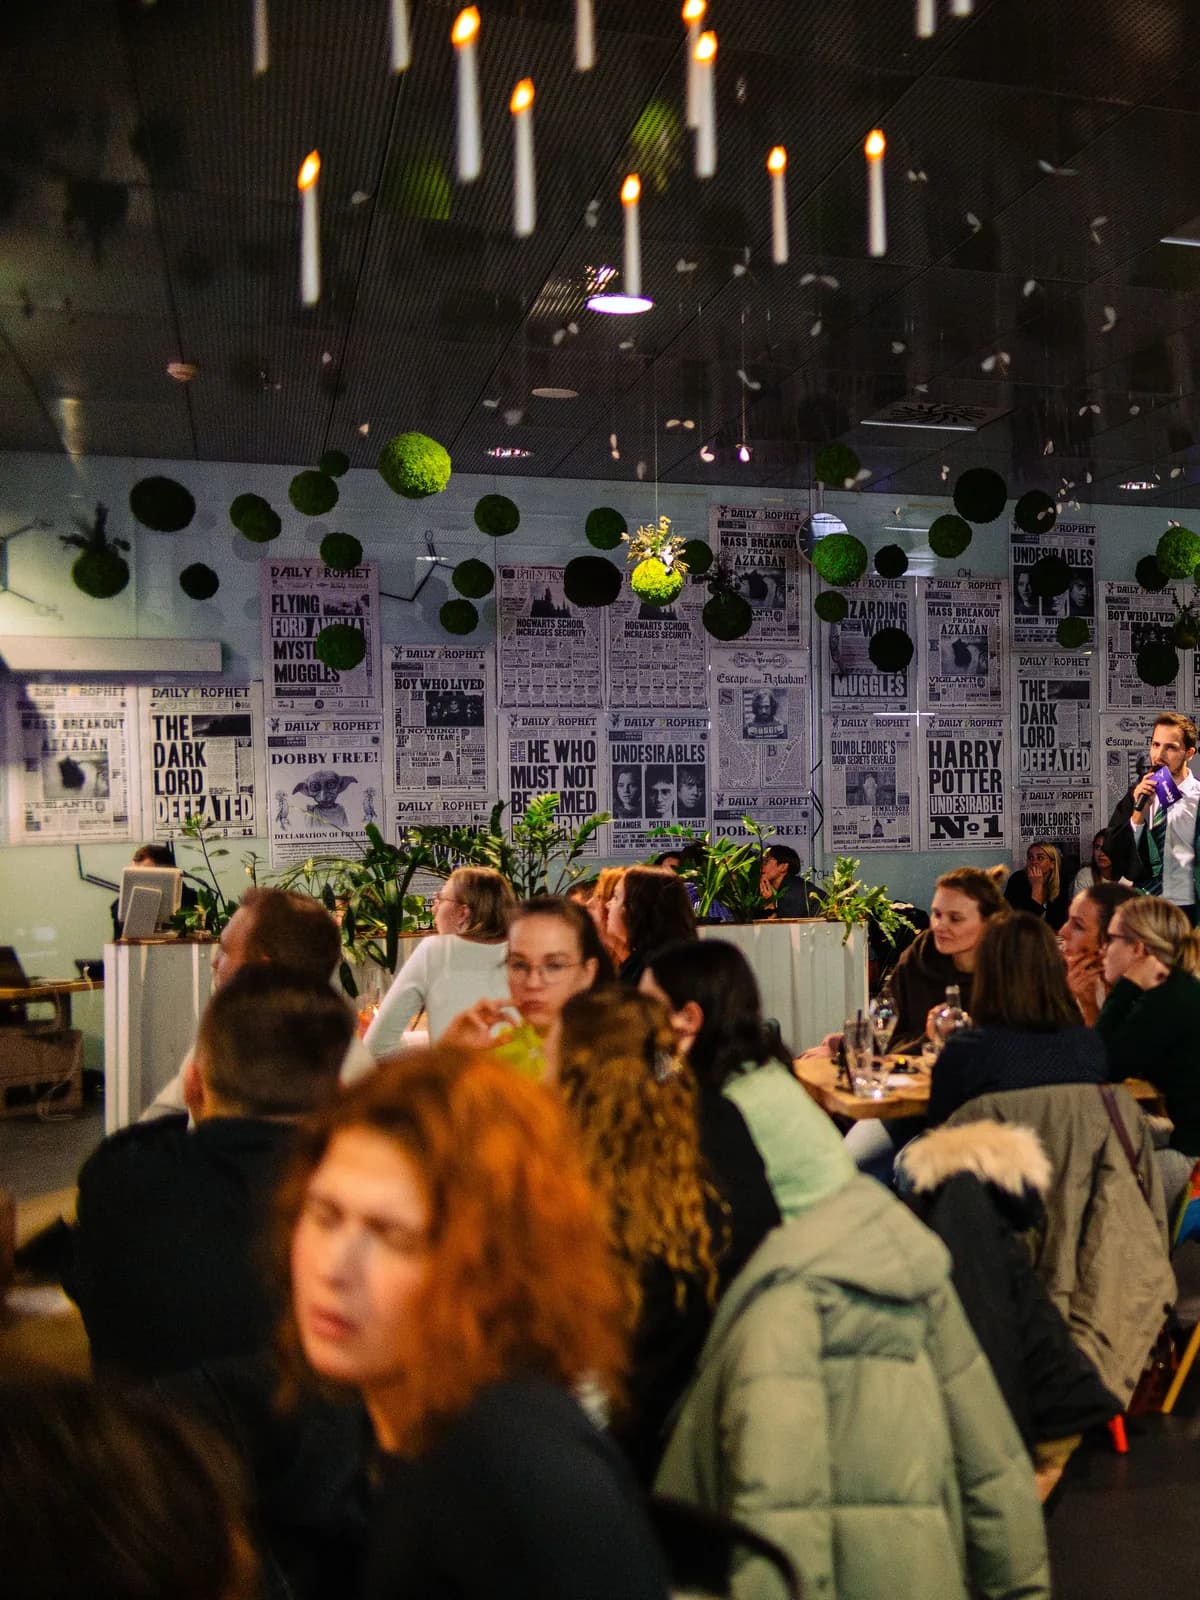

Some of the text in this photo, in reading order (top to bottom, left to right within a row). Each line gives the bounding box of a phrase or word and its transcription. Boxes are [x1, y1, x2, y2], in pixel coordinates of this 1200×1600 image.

[730, 509, 758, 519] DAILY
[720, 537, 798, 549] MASS BREAKOUT
[734, 555, 786, 567] AZKABAN
[270, 566, 312, 578] DAILY
[937, 580, 961, 589] DAILY
[1116, 586, 1139, 594] DAILY
[271, 594, 320, 614] FLYING
[846, 600, 907, 620] ZARDING
[927, 607, 1000, 618] MASS BREAKOUT
[1108, 610, 1126, 621] BOY
[1127, 611, 1149, 622] WHO
[271, 617, 307, 637] FORD
[516, 619, 585, 629] HOGWARTS SCHOOL
[624, 621, 690, 631] HOGWARTS SCHOOL
[940, 624, 988, 635] AZKABAN
[515, 628, 587, 638] INCREASES SECURITY
[624, 630, 692, 640] INCREASES SECURITY
[406, 649, 486, 659] DAILY PROPHET
[1020, 656, 1047, 666] DAILY
[274, 663, 340, 683] MUGGLES
[394, 679, 484, 690] BOY WHO LIVED
[716, 673, 749, 685] Escape
[762, 673, 807, 686] Azkaban!
[833, 674, 905, 697] MUGGLES
[152, 687, 191, 698] DAILY
[1020, 680, 1046, 702] THE
[1020, 702, 1058, 725] DARK
[63, 718, 125, 730] BREAKOUT
[152, 714, 190, 741] THE
[284, 721, 320, 731] DAILY
[521, 717, 598, 726] DAILY PROPHET
[624, 718, 656, 727] DAILY
[841, 719, 868, 728] DAILY
[938, 719, 963, 728] DAILY
[1020, 726, 1055, 748] LORD
[1105, 736, 1134, 748] Escape
[527, 740, 550, 763] HE
[553, 739, 596, 763] WHO
[612, 743, 706, 763] UNDESIRABLES
[831, 740, 896, 755] DUMBLEDORE'S
[153, 741, 207, 769] DARK
[271, 751, 378, 765] DOBBY FREE!
[847, 755, 870, 765] SECRETS
[871, 755, 896, 765] REVEALED
[928, 740, 1002, 769] HARRY
[1020, 748, 1091, 771] DEFEATED
[154, 768, 204, 796] LORD
[510, 764, 597, 789] MUST NOT
[928, 769, 1002, 794] POTTER
[728, 797, 759, 806] DAILY
[1029, 791, 1055, 800] DAILY
[398, 801, 433, 811] DAILY
[536, 790, 597, 814] MED
[930, 795, 1002, 814] UNDESIRABLE
[156, 795, 254, 823] DEFEATED
[648, 820, 671, 828] POTTER
[1020, 812, 1080, 826] DUMBLEDORE'S
[274, 832, 327, 840] DECLARATION
[329, 831, 339, 839] OF
[716, 825, 760, 836] DOB
[1035, 827, 1056, 836] SECRETS
[1057, 827, 1081, 836] REVEALED
